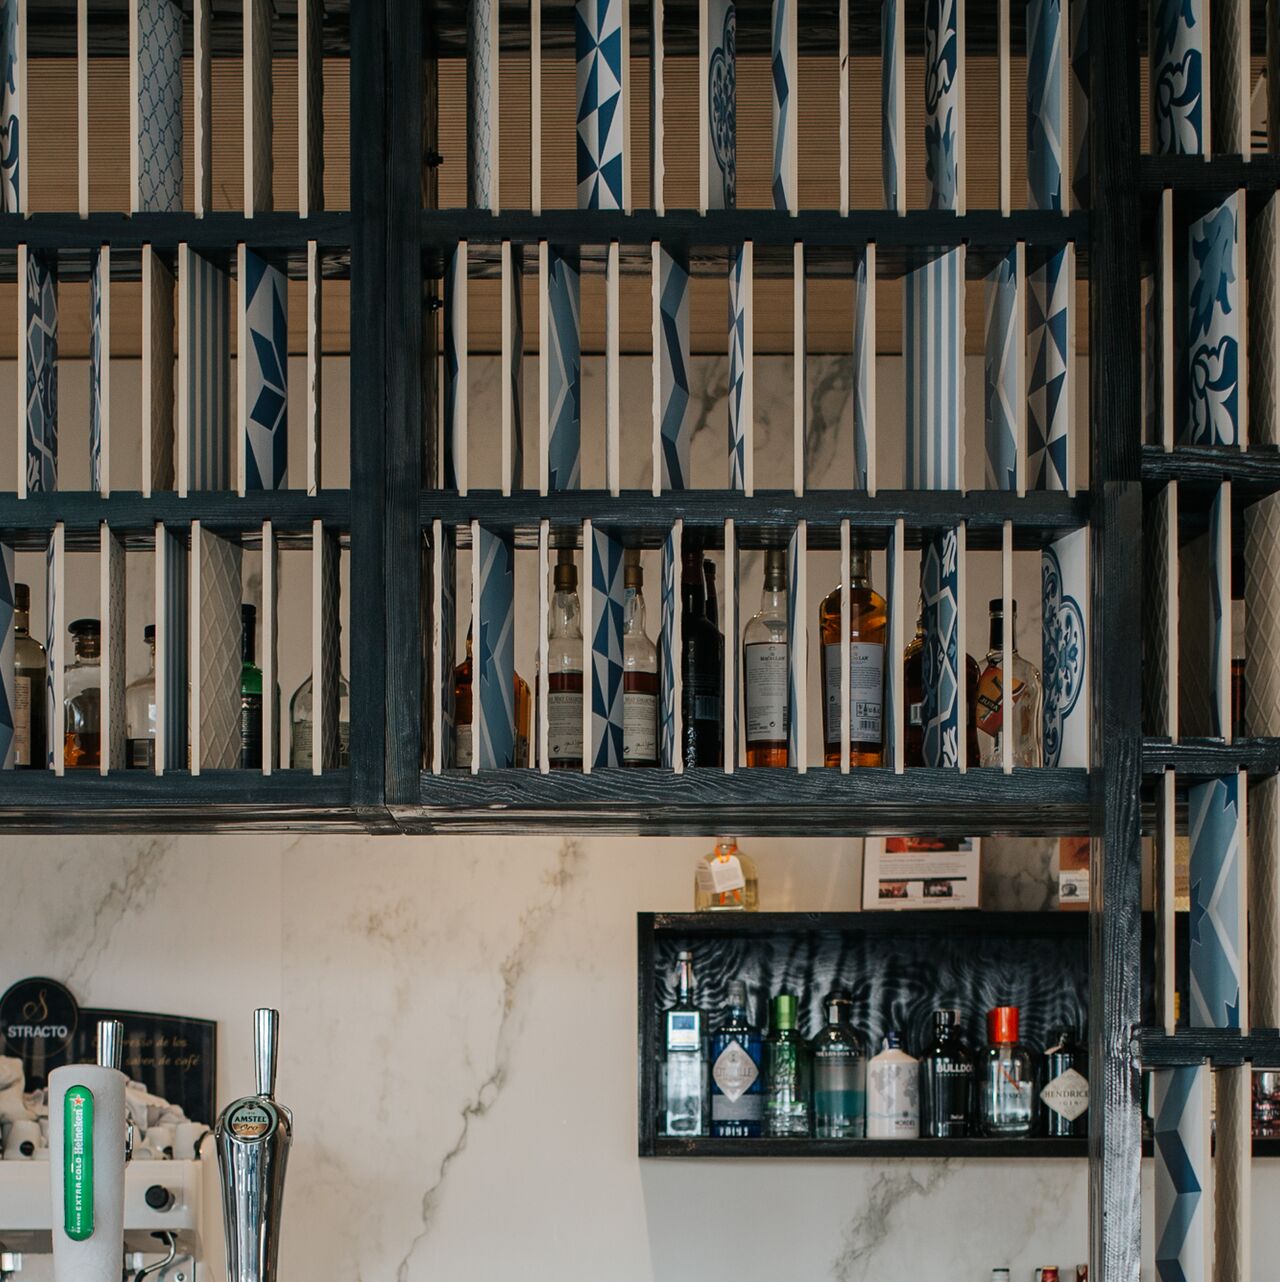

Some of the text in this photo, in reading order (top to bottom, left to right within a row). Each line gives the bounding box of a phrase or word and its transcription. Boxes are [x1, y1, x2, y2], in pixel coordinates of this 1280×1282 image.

[7, 1024, 68, 1038] STRACTO
[174, 1054, 200, 1072] café
[234, 1115, 267, 1123] AMSTEL
[73, 1109, 85, 1155] Heineken
